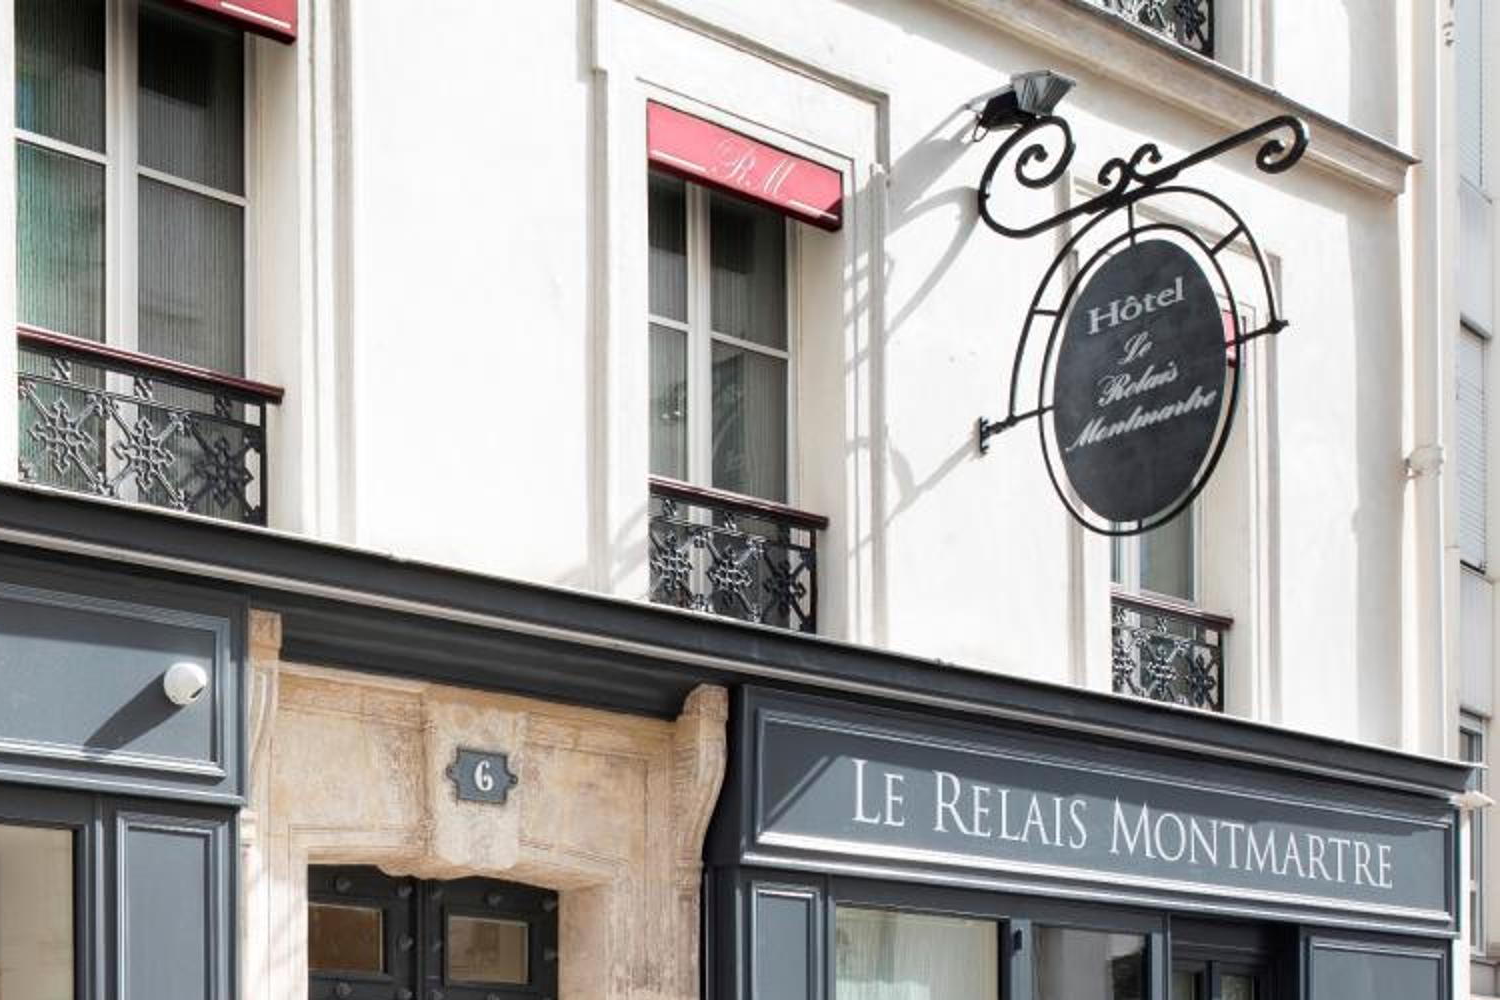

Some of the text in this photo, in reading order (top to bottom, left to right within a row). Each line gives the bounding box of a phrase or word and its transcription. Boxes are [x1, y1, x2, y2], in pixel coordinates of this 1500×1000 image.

[1088, 277, 1185, 335] Hôtel
[1118, 331, 1153, 365] Le
[1098, 361, 1180, 408] Relais
[1064, 385, 1217, 451] Montmartre
[474, 760, 493, 791] 6
[852, 760, 1393, 888] LE RELAIS MONTMARTRE
